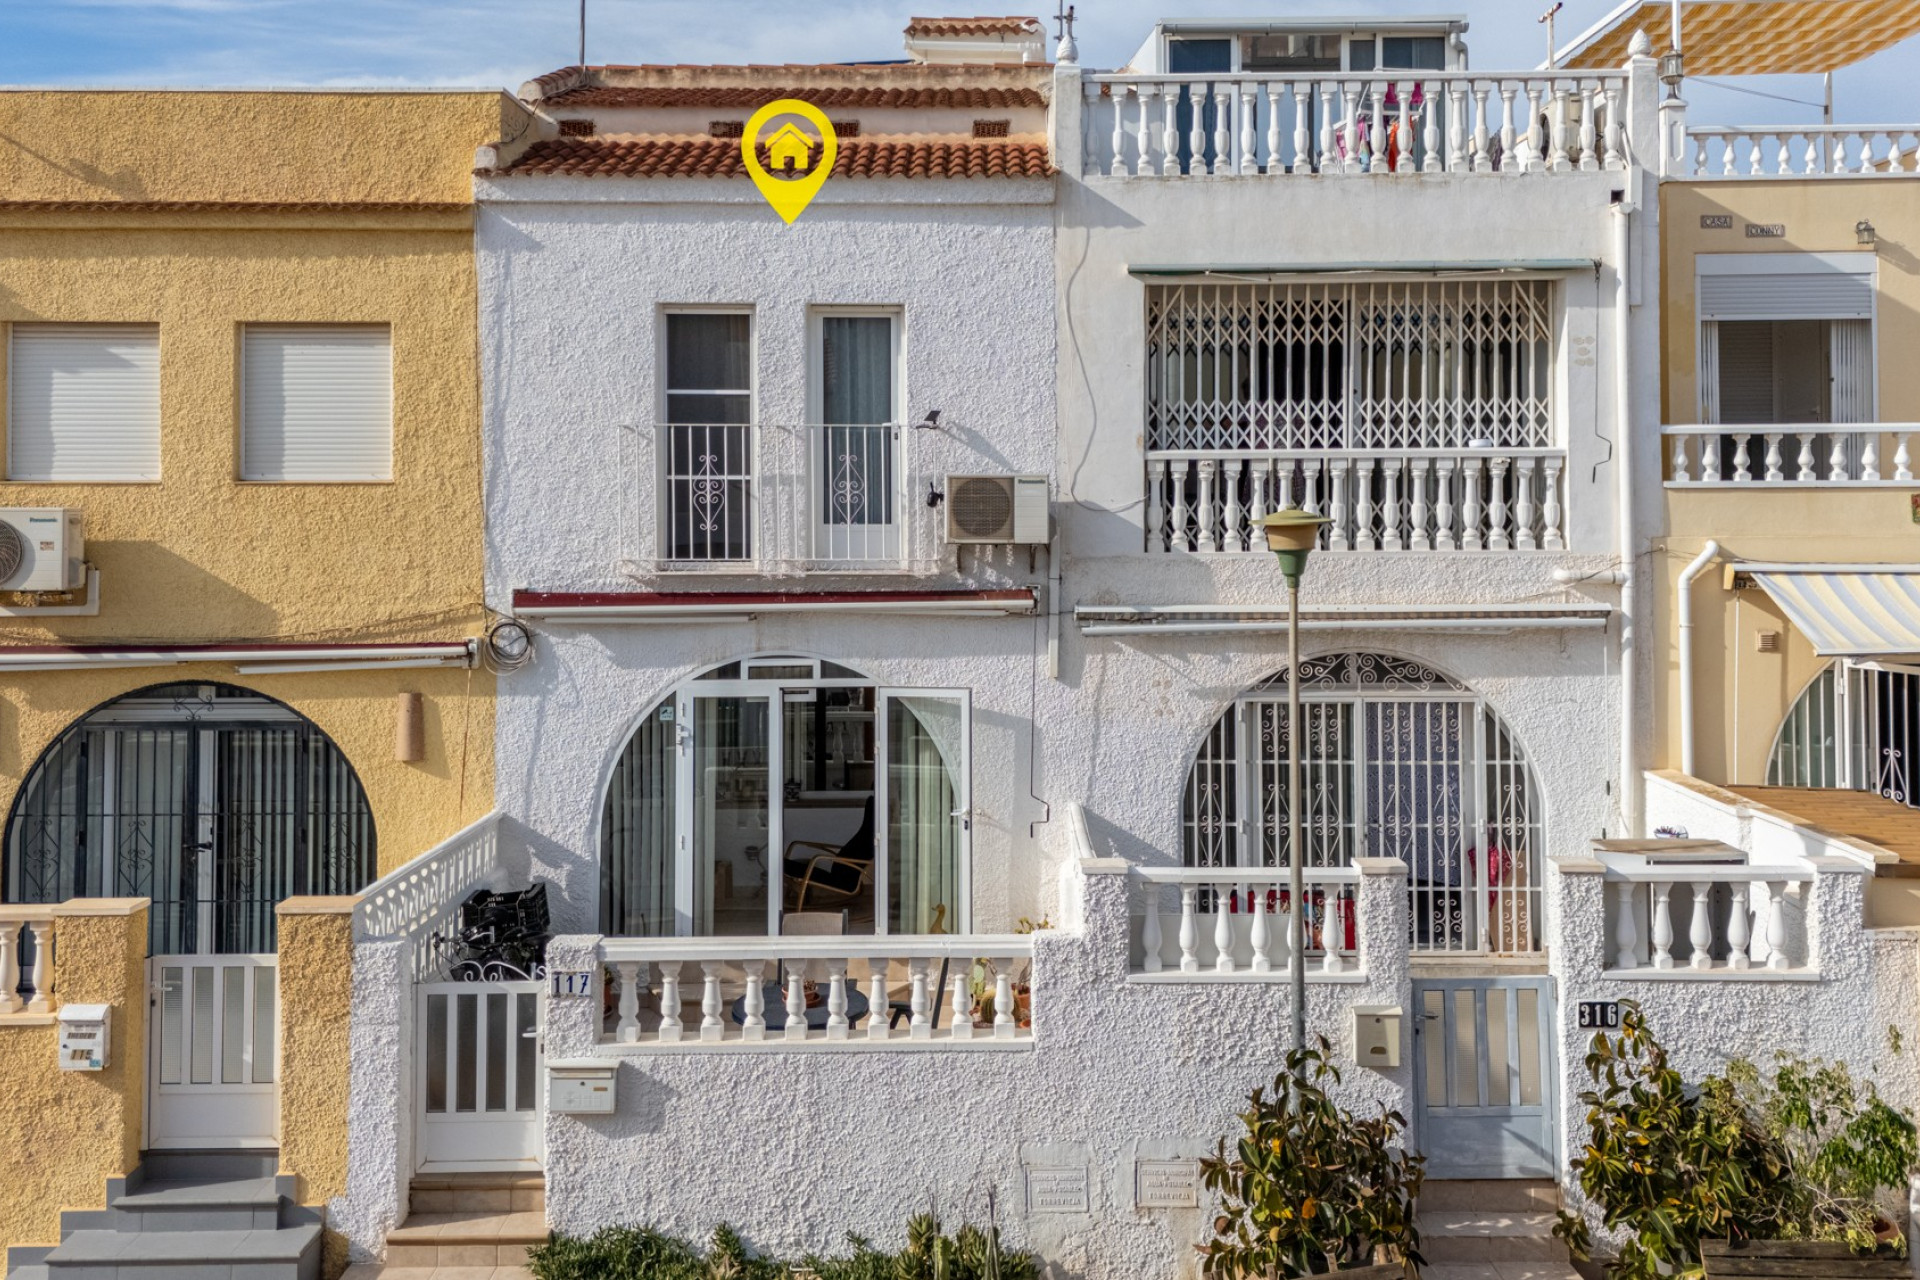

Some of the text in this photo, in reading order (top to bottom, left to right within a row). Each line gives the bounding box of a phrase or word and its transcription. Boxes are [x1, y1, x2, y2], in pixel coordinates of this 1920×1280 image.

[1703, 216, 1729, 227] CASA
[554, 975, 589, 993] 117
[1580, 1004, 1617, 1026] 316
